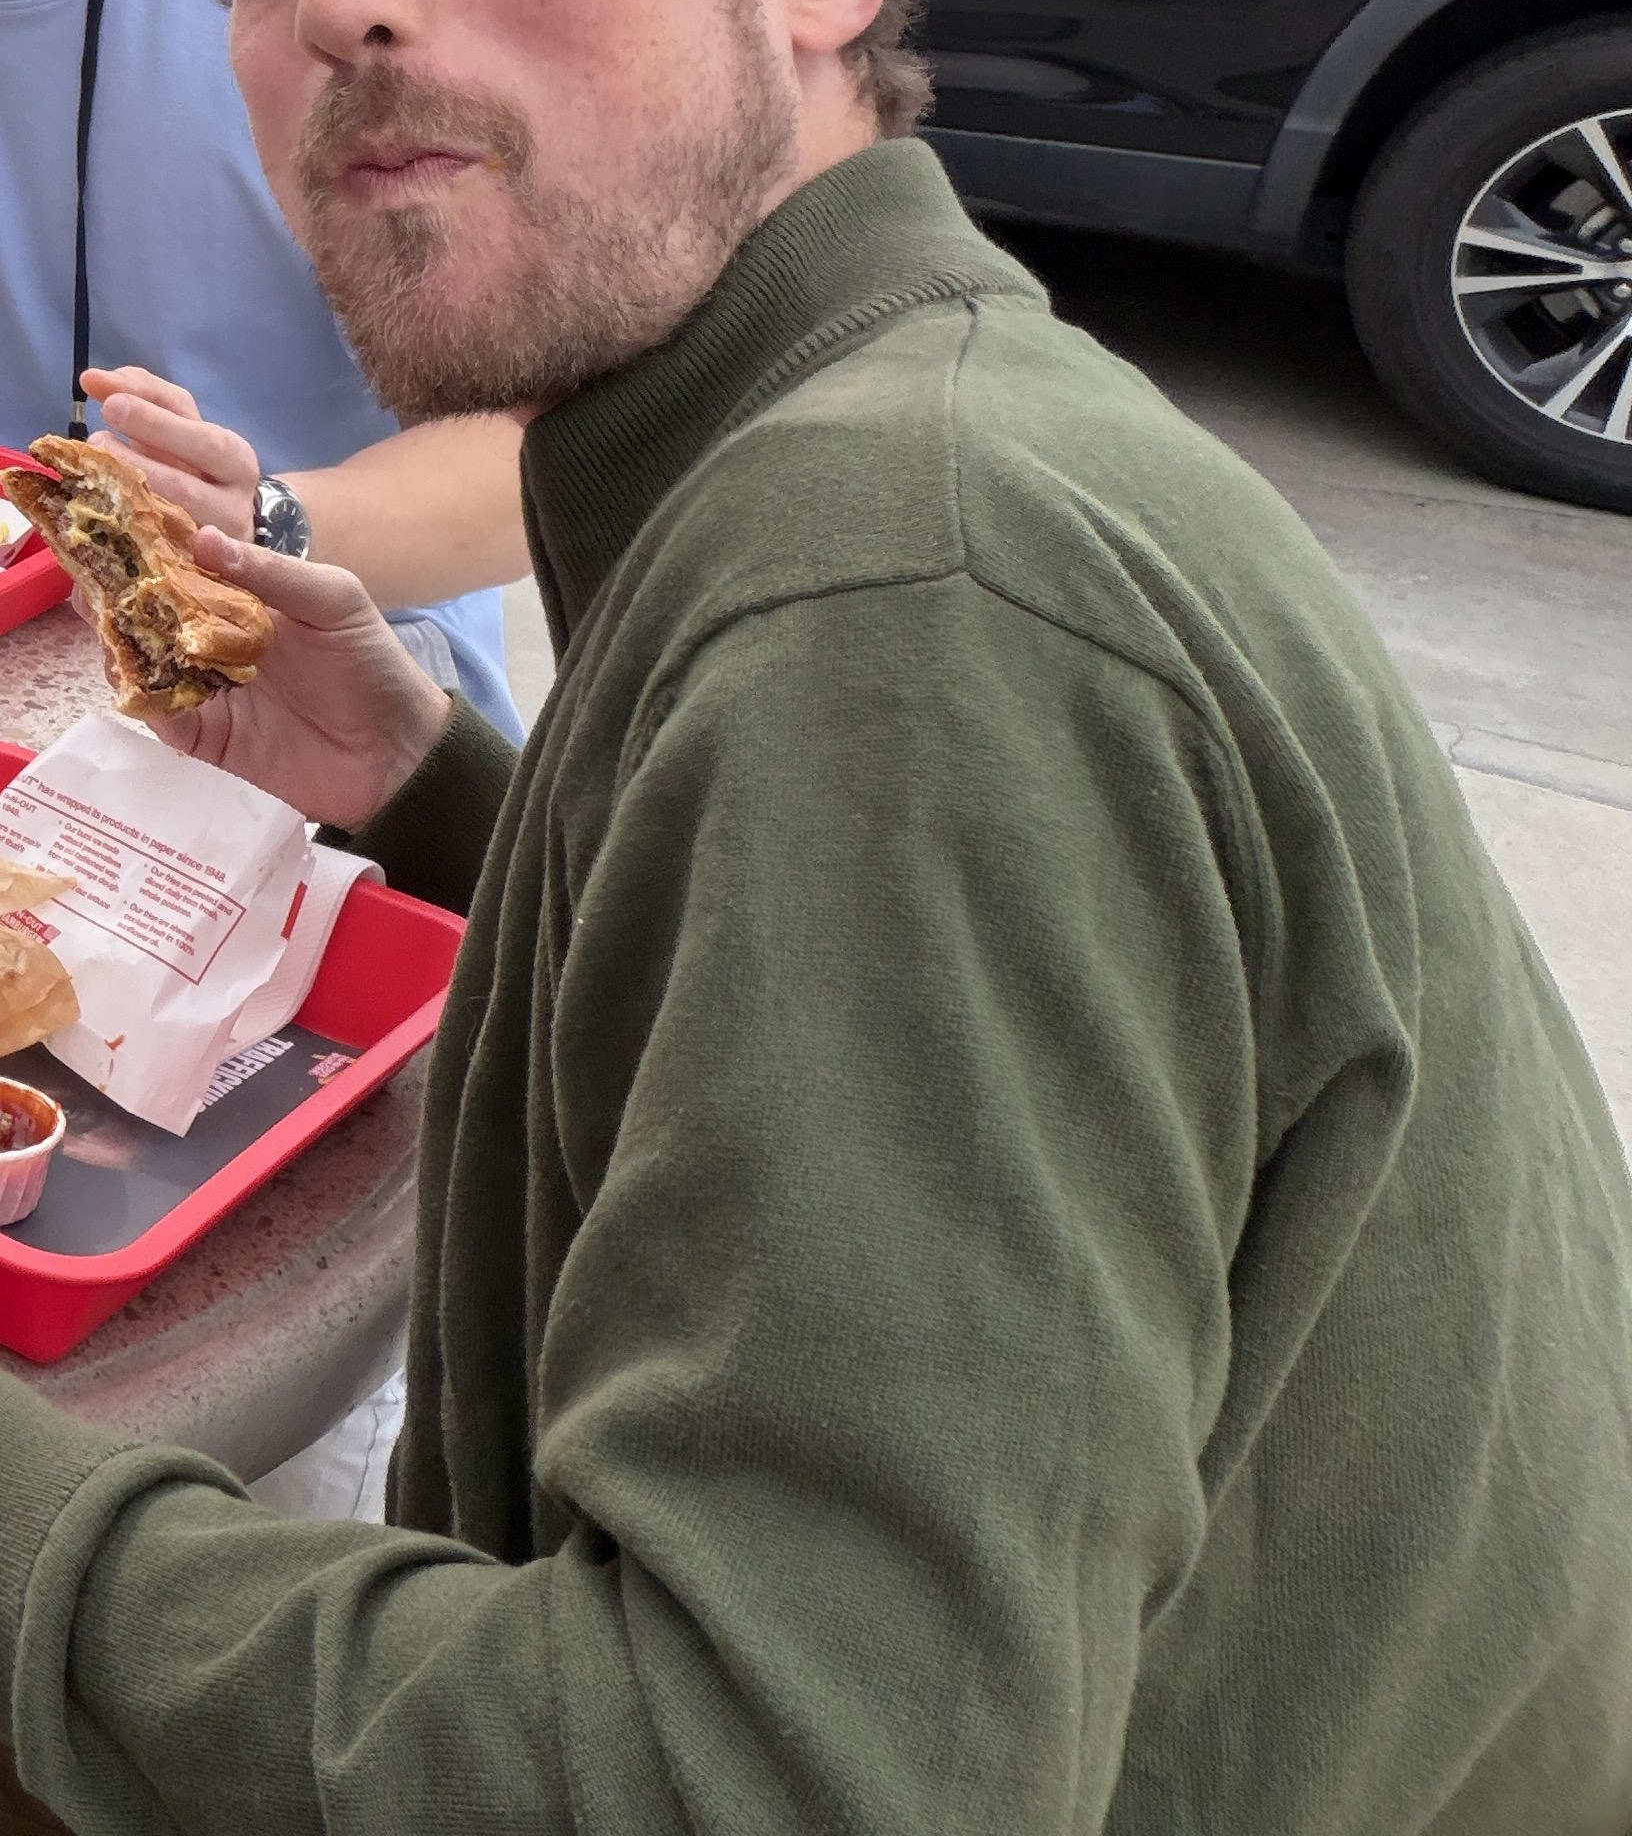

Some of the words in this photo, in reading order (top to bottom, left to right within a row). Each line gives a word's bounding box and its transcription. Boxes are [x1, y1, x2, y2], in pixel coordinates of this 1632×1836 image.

[37, 782, 55, 796] has
[56, 792, 90, 815] wrapped
[100, 814, 140, 839] products
[140, 833, 151, 844] in
[148, 839, 177, 858] paper
[176, 852, 203, 871] since
[65, 823, 76, 834] Our
[144, 876, 165, 892] diced
[150, 866, 165, 878] Our
[165, 874, 181, 887] fries
[217, 903, 233, 917] and
[129, 903, 143, 914] Our
[143, 910, 158, 924] fries
[165, 933, 174, 943] in
